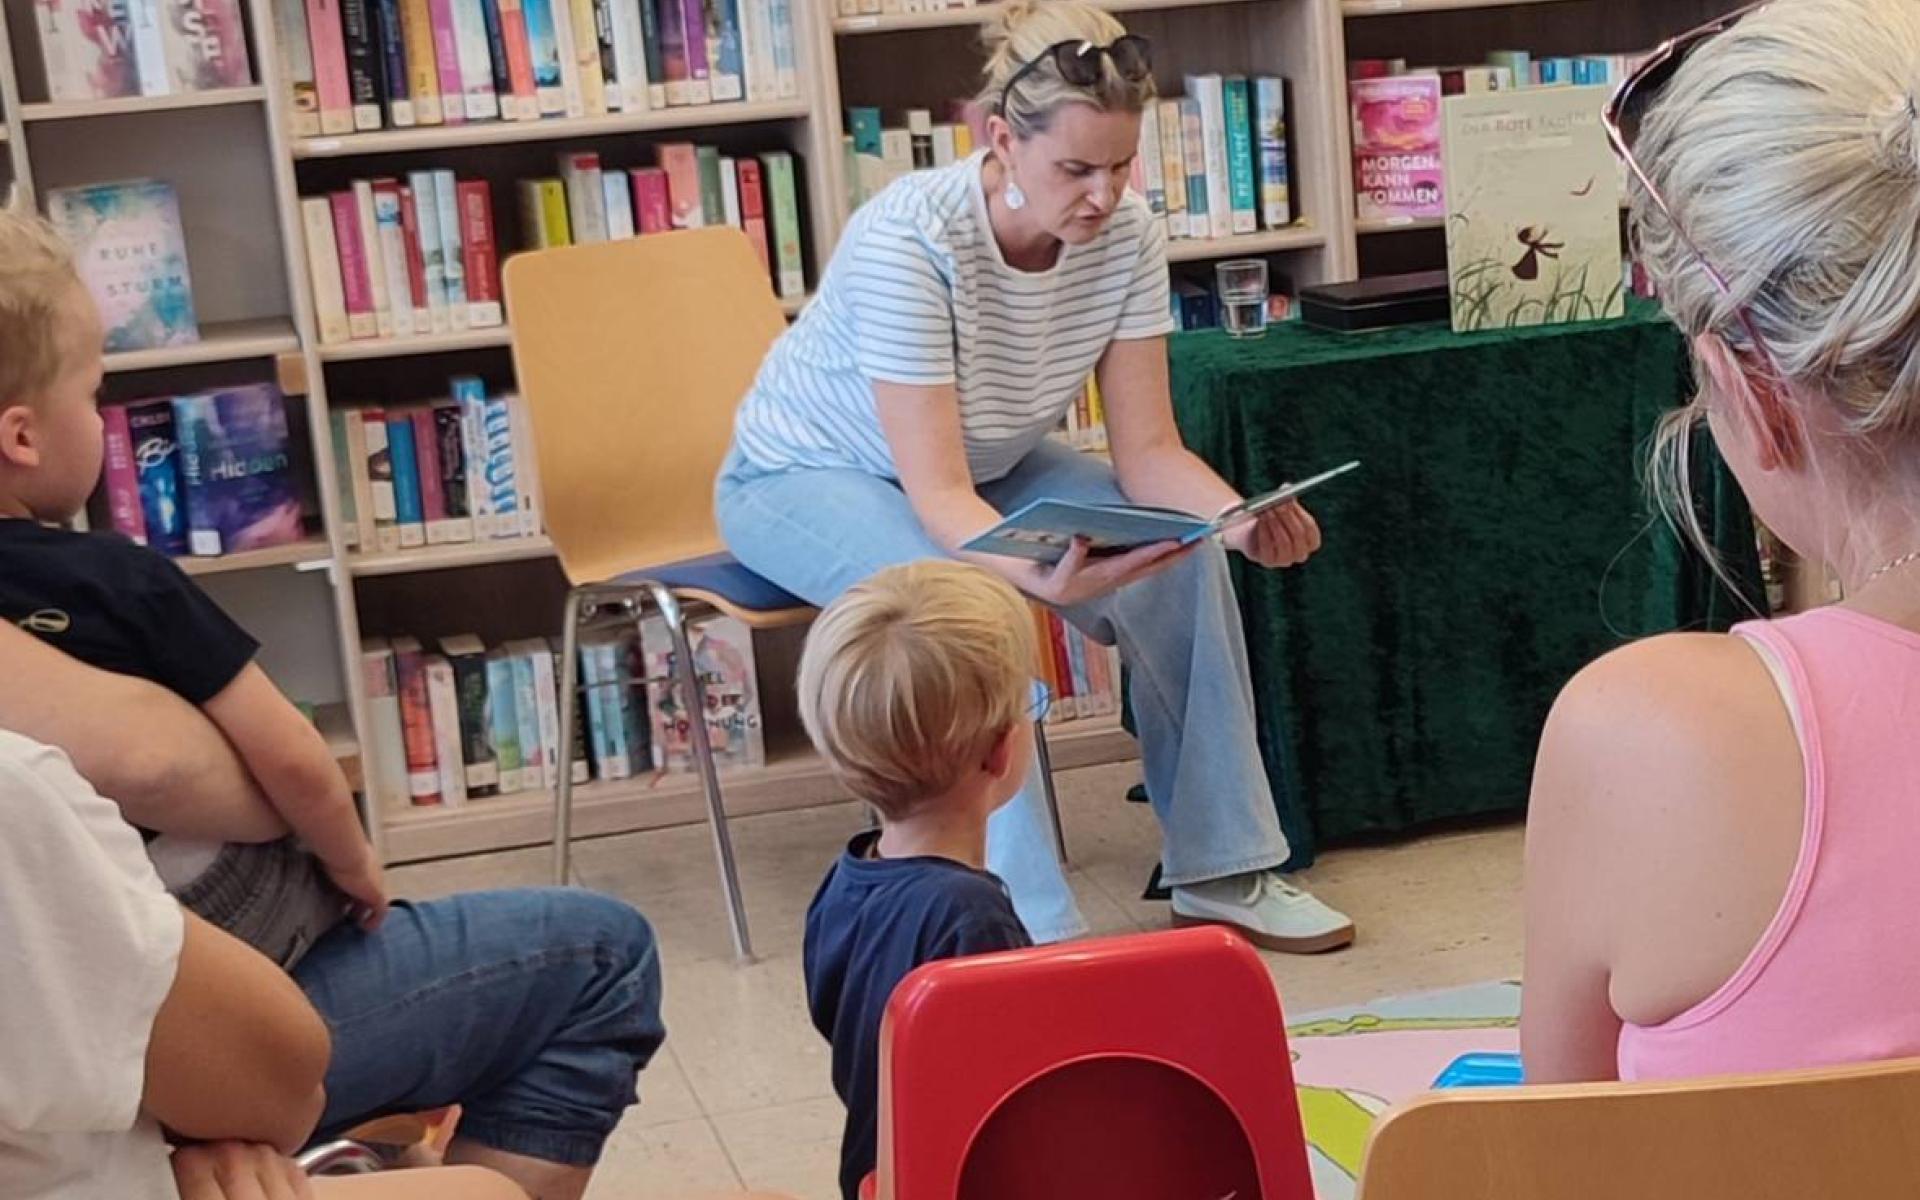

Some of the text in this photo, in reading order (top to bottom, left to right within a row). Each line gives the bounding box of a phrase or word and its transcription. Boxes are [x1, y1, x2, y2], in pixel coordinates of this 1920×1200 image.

[1362, 173, 1410, 187] KANN
[100, 242, 158, 261] RUHE
[106, 275, 182, 298] STURM
